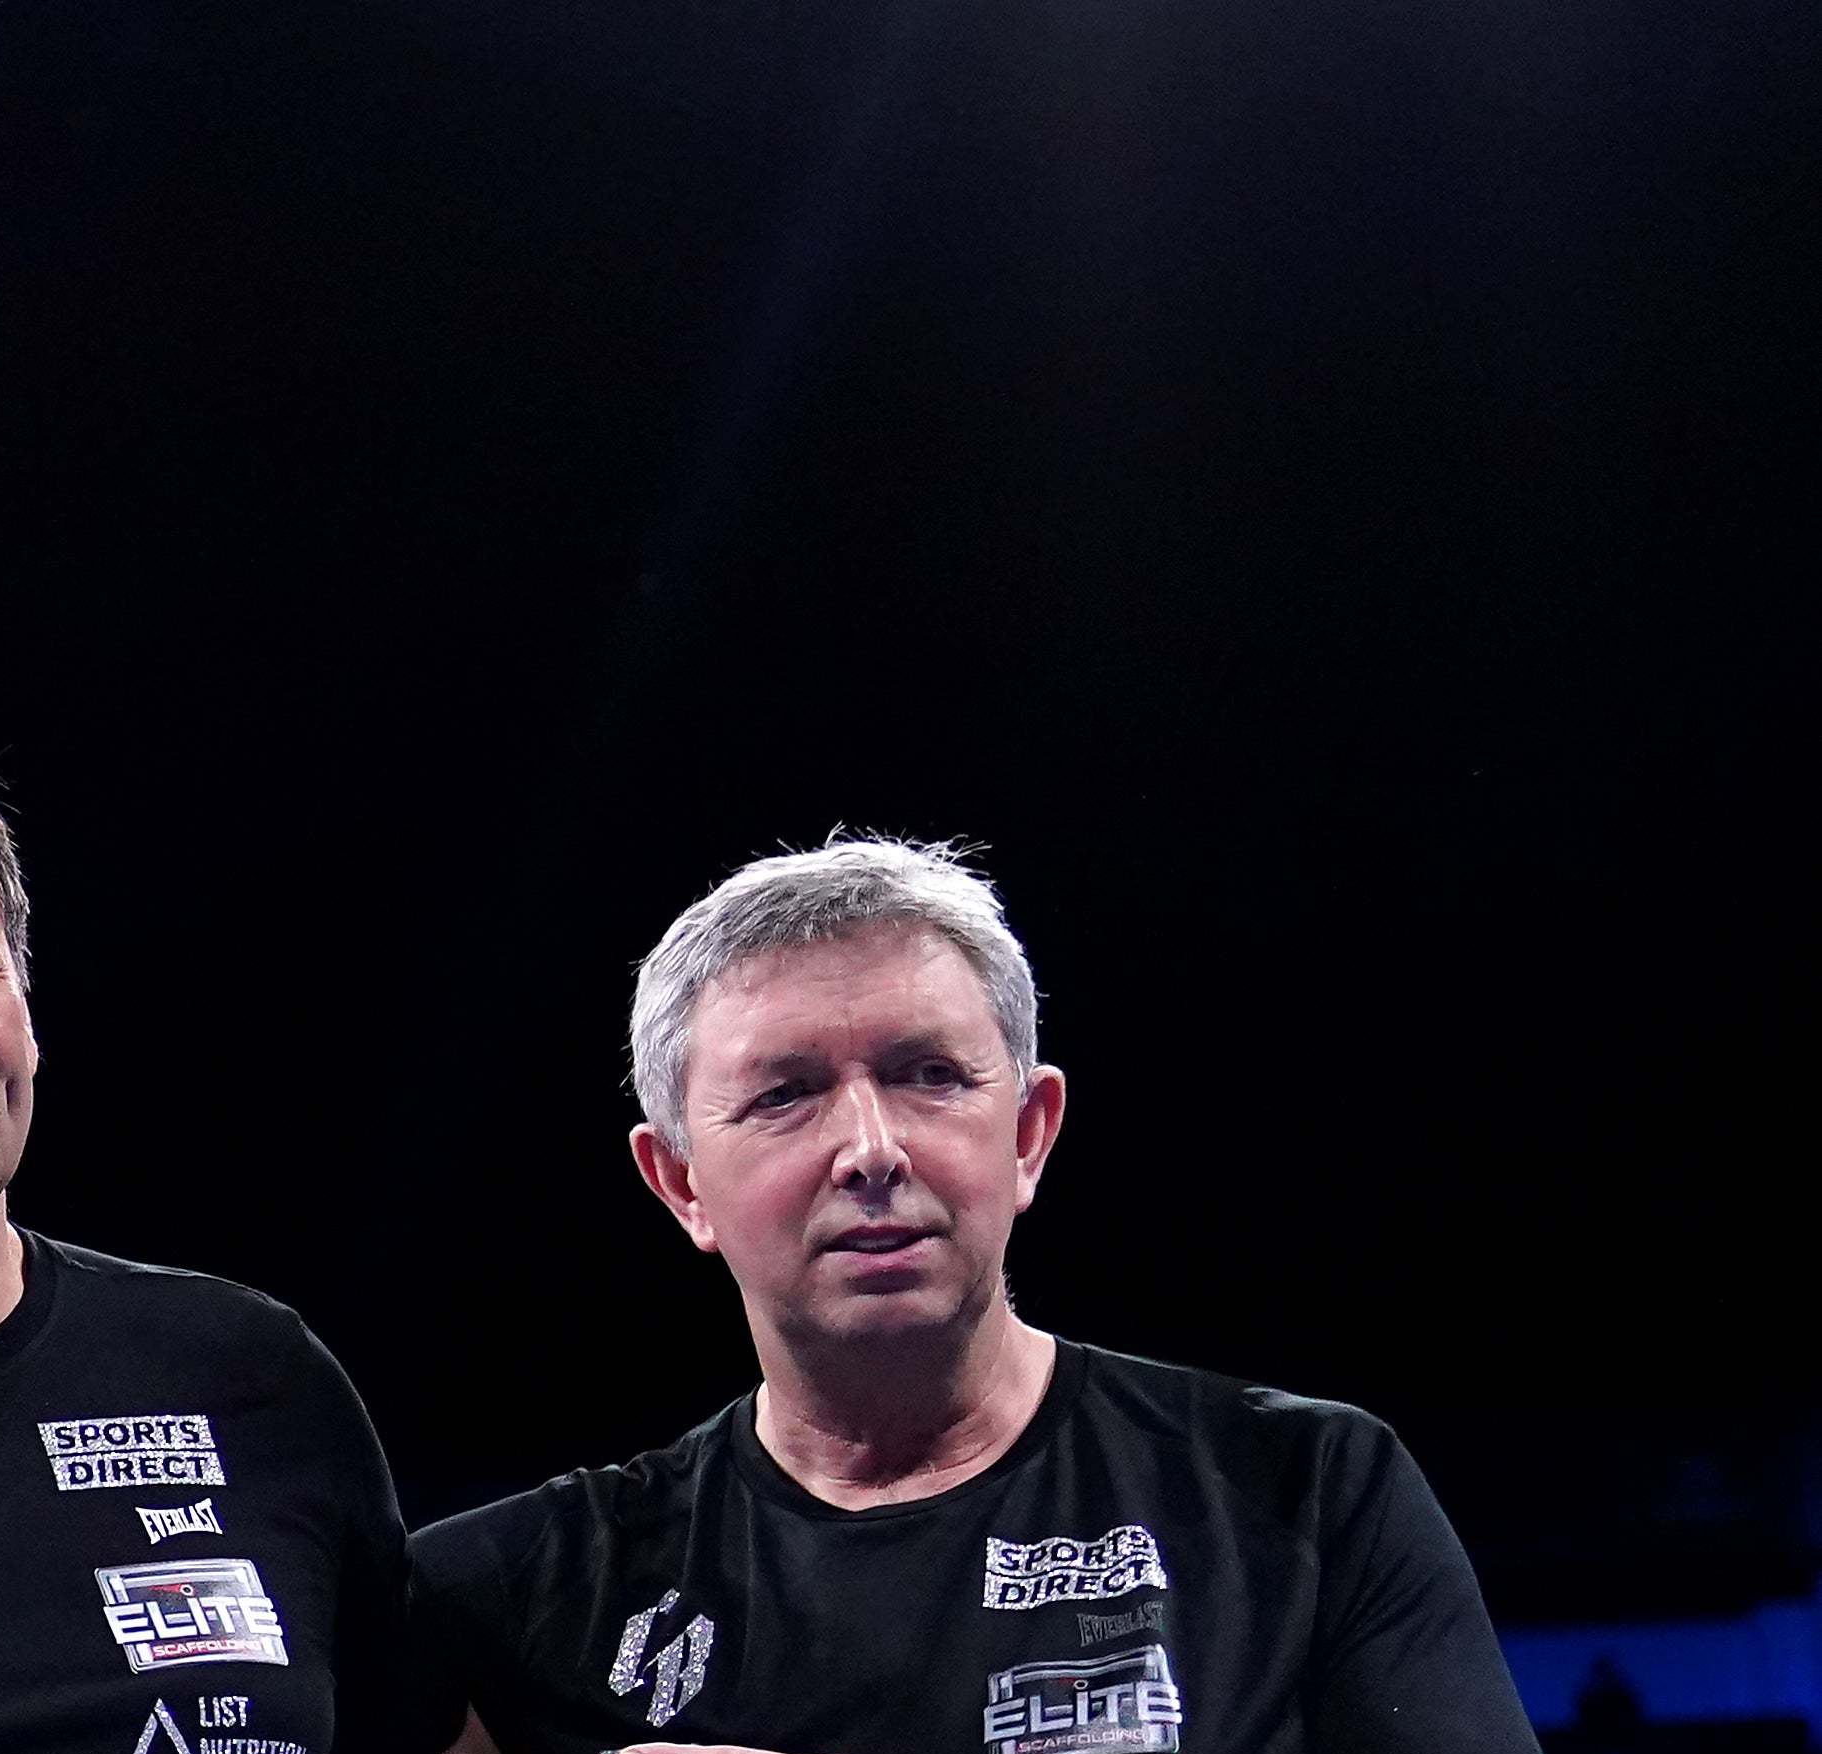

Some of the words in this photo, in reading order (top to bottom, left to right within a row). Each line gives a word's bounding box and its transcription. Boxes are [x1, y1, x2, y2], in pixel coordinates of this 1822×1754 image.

[55, 1421, 201, 1449] SPORTS
[67, 1456, 207, 1485] DIRECT
[134, 1497, 223, 1545] EVERLAST
[998, 1529, 1151, 1572] SPORTS
[997, 1558, 1153, 1604] DIRECT
[103, 1597, 284, 1645] ELITE
[1076, 1602, 1164, 1647] EVERLAST
[152, 1639, 262, 1658] SCAFFOLDING
[198, 1695, 249, 1728] LIST
[983, 1680, 1184, 1744] ELITE
[1016, 1728, 1147, 1753] SCAFFOLDING
